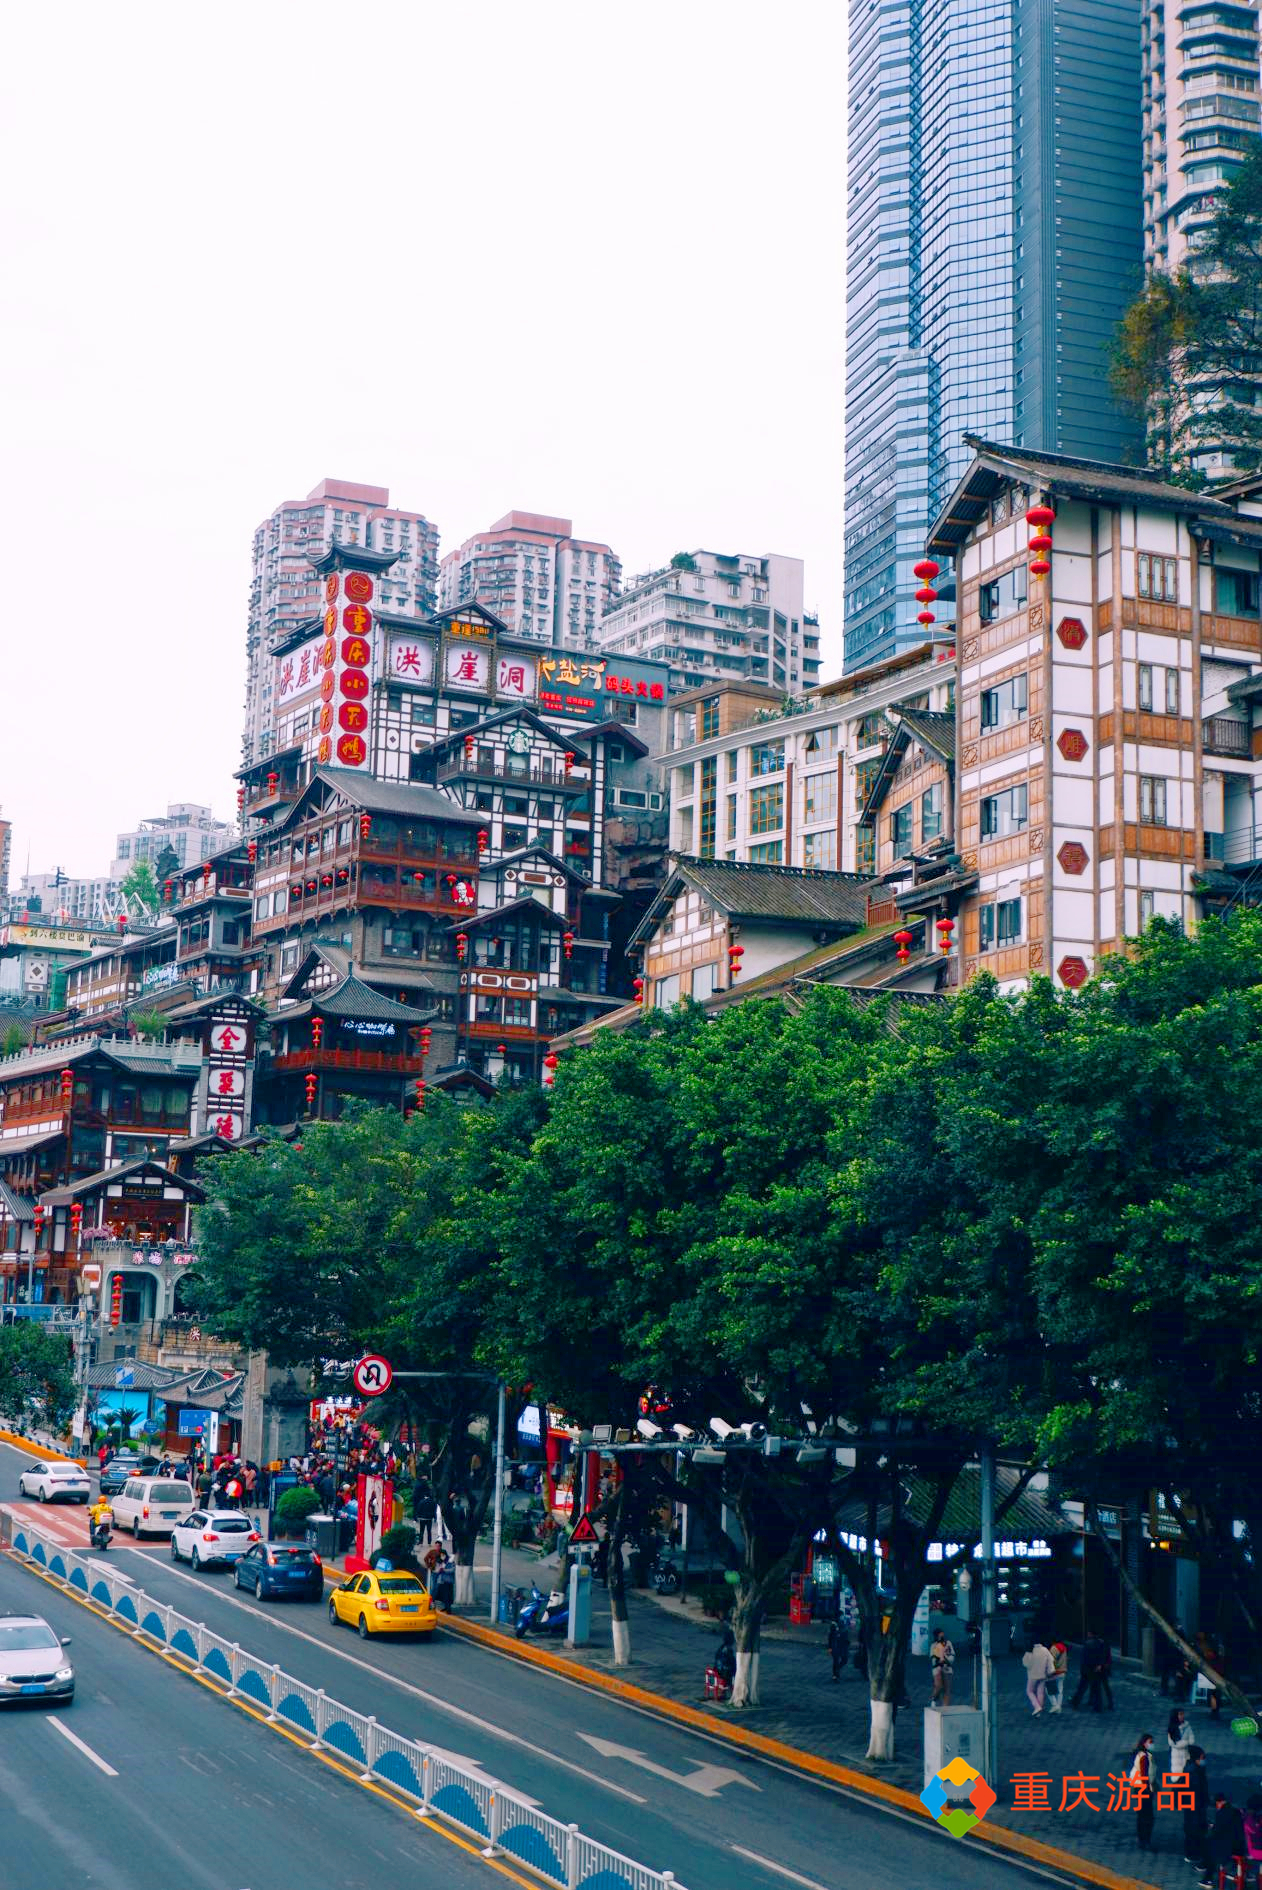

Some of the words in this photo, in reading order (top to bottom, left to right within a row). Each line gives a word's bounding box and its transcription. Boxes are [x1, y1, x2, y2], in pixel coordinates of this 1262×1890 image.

[342, 604, 367, 767] 重庆小天鹅
[396, 645, 526, 693] 洪崖洞
[605, 674, 664, 700] 码头火锅
